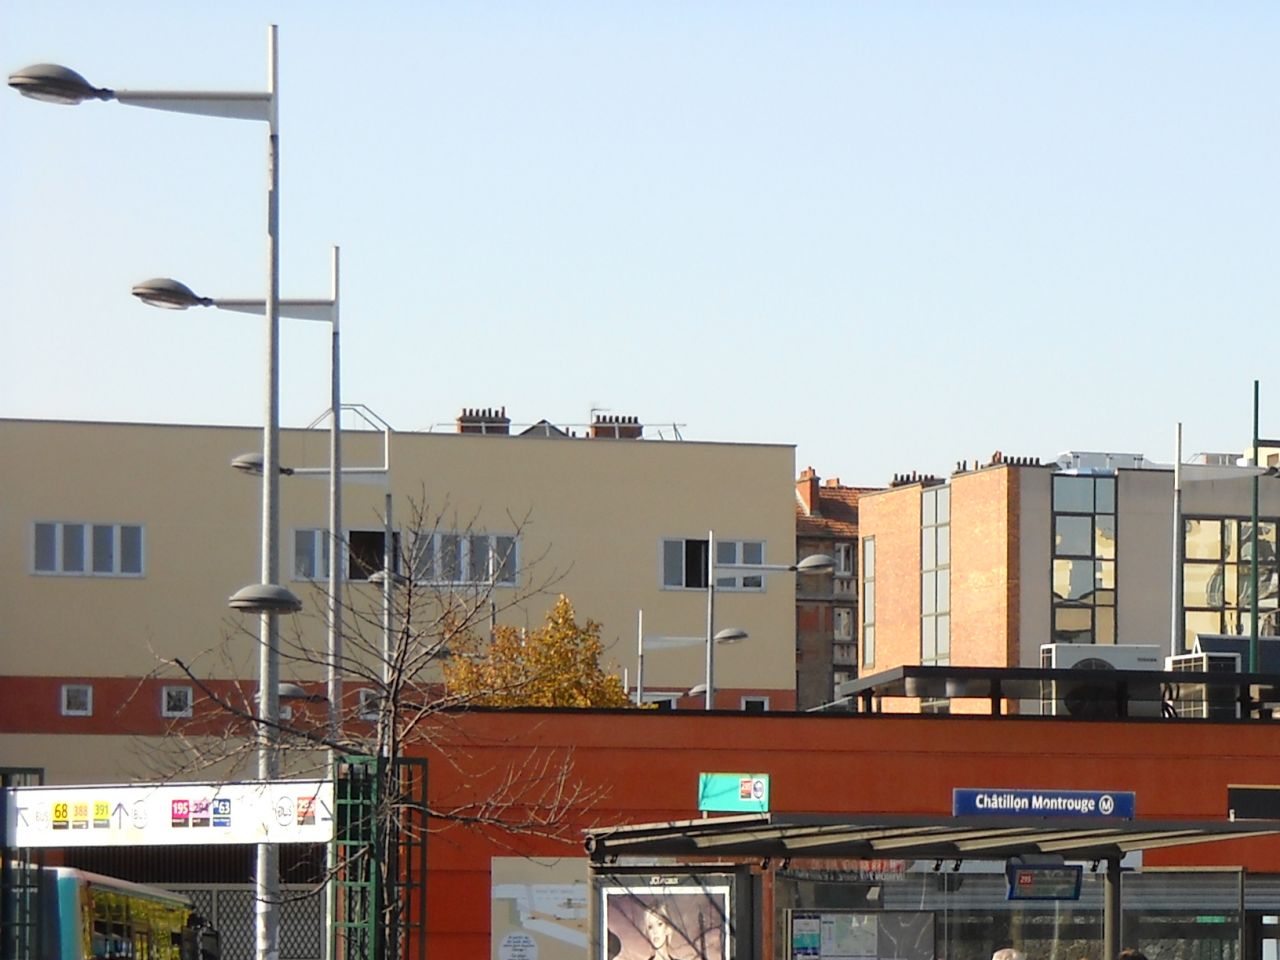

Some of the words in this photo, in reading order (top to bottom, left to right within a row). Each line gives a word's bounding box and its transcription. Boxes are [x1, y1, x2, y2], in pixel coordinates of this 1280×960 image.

[95, 804, 109, 815] 391
[173, 802, 189, 815] 195
[976, 794, 1029, 812] Châtillon
[1032, 796, 1095, 812] Montrouge
[54, 804, 68, 818] 68
